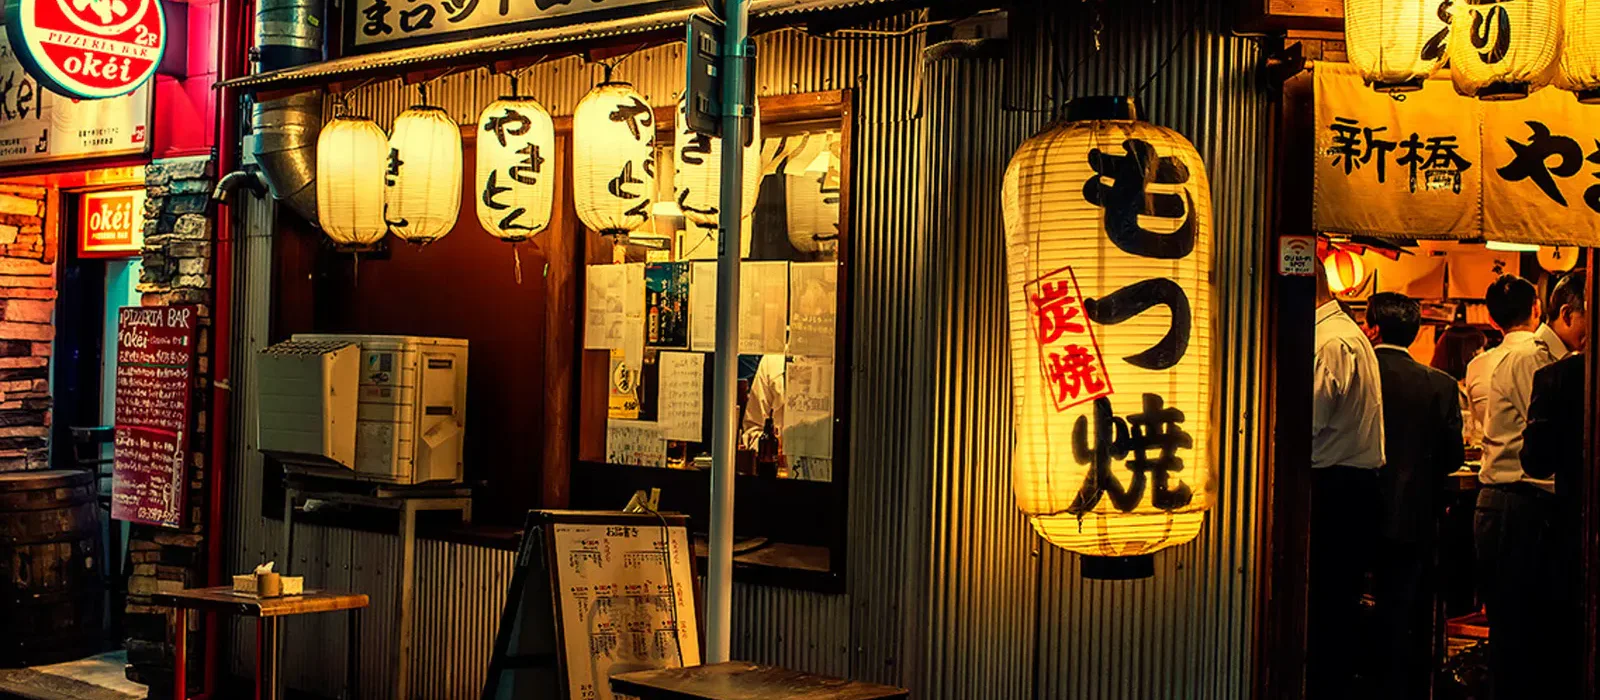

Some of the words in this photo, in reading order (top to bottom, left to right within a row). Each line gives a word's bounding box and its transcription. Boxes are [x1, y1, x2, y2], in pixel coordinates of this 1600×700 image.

[48, 32, 115, 51] PIZZERIA
[122, 45, 148, 57] BAR
[1466, 0, 1512, 64] り
[63, 52, 131, 82] okéi
[482, 108, 545, 231] やきとん
[1328, 116, 1472, 195] 新橋
[89, 202, 131, 231] okéi
[167, 308, 190, 329] BAR
[1031, 280, 1107, 404] 炭焼
[1071, 138, 1197, 514] もつ焼
